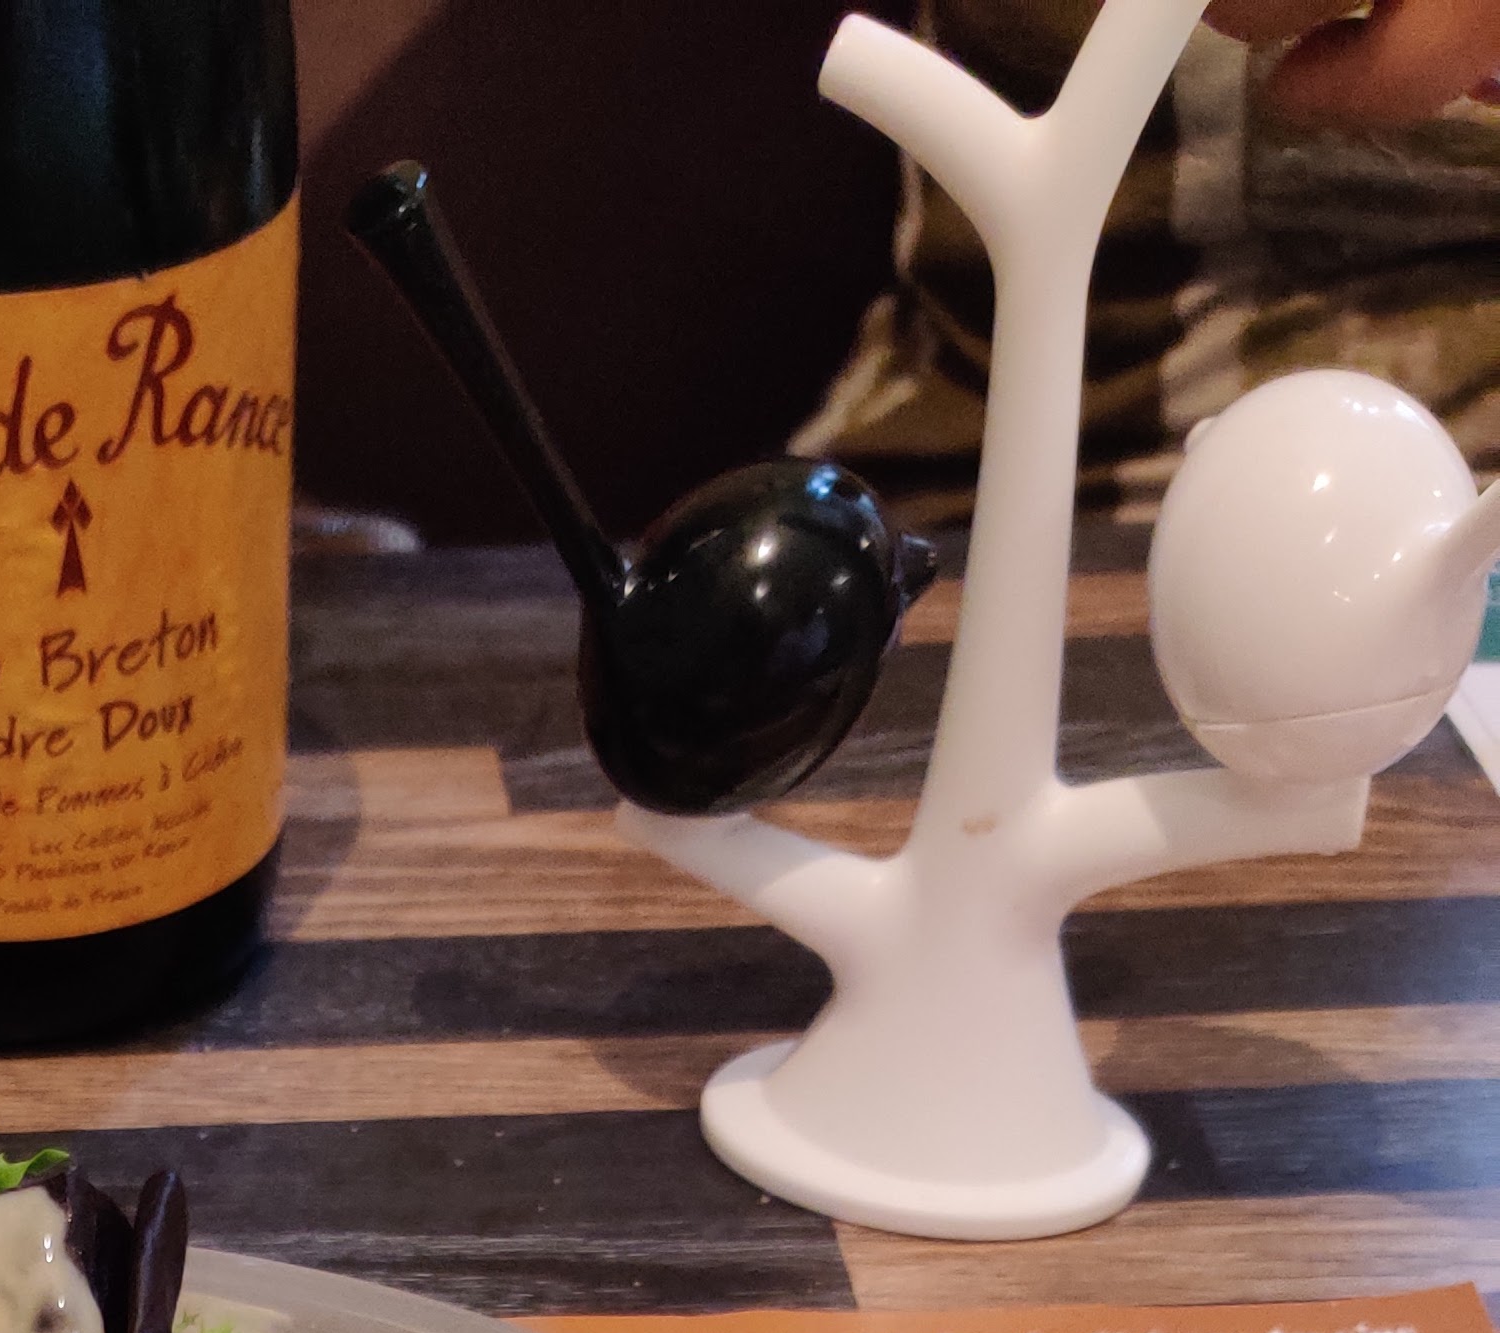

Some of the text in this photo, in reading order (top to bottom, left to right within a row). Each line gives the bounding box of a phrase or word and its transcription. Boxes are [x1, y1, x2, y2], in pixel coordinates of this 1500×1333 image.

[97, 294, 291, 465] Rance
[40, 606, 220, 691] Breton
[101, 694, 195, 750] Doux
